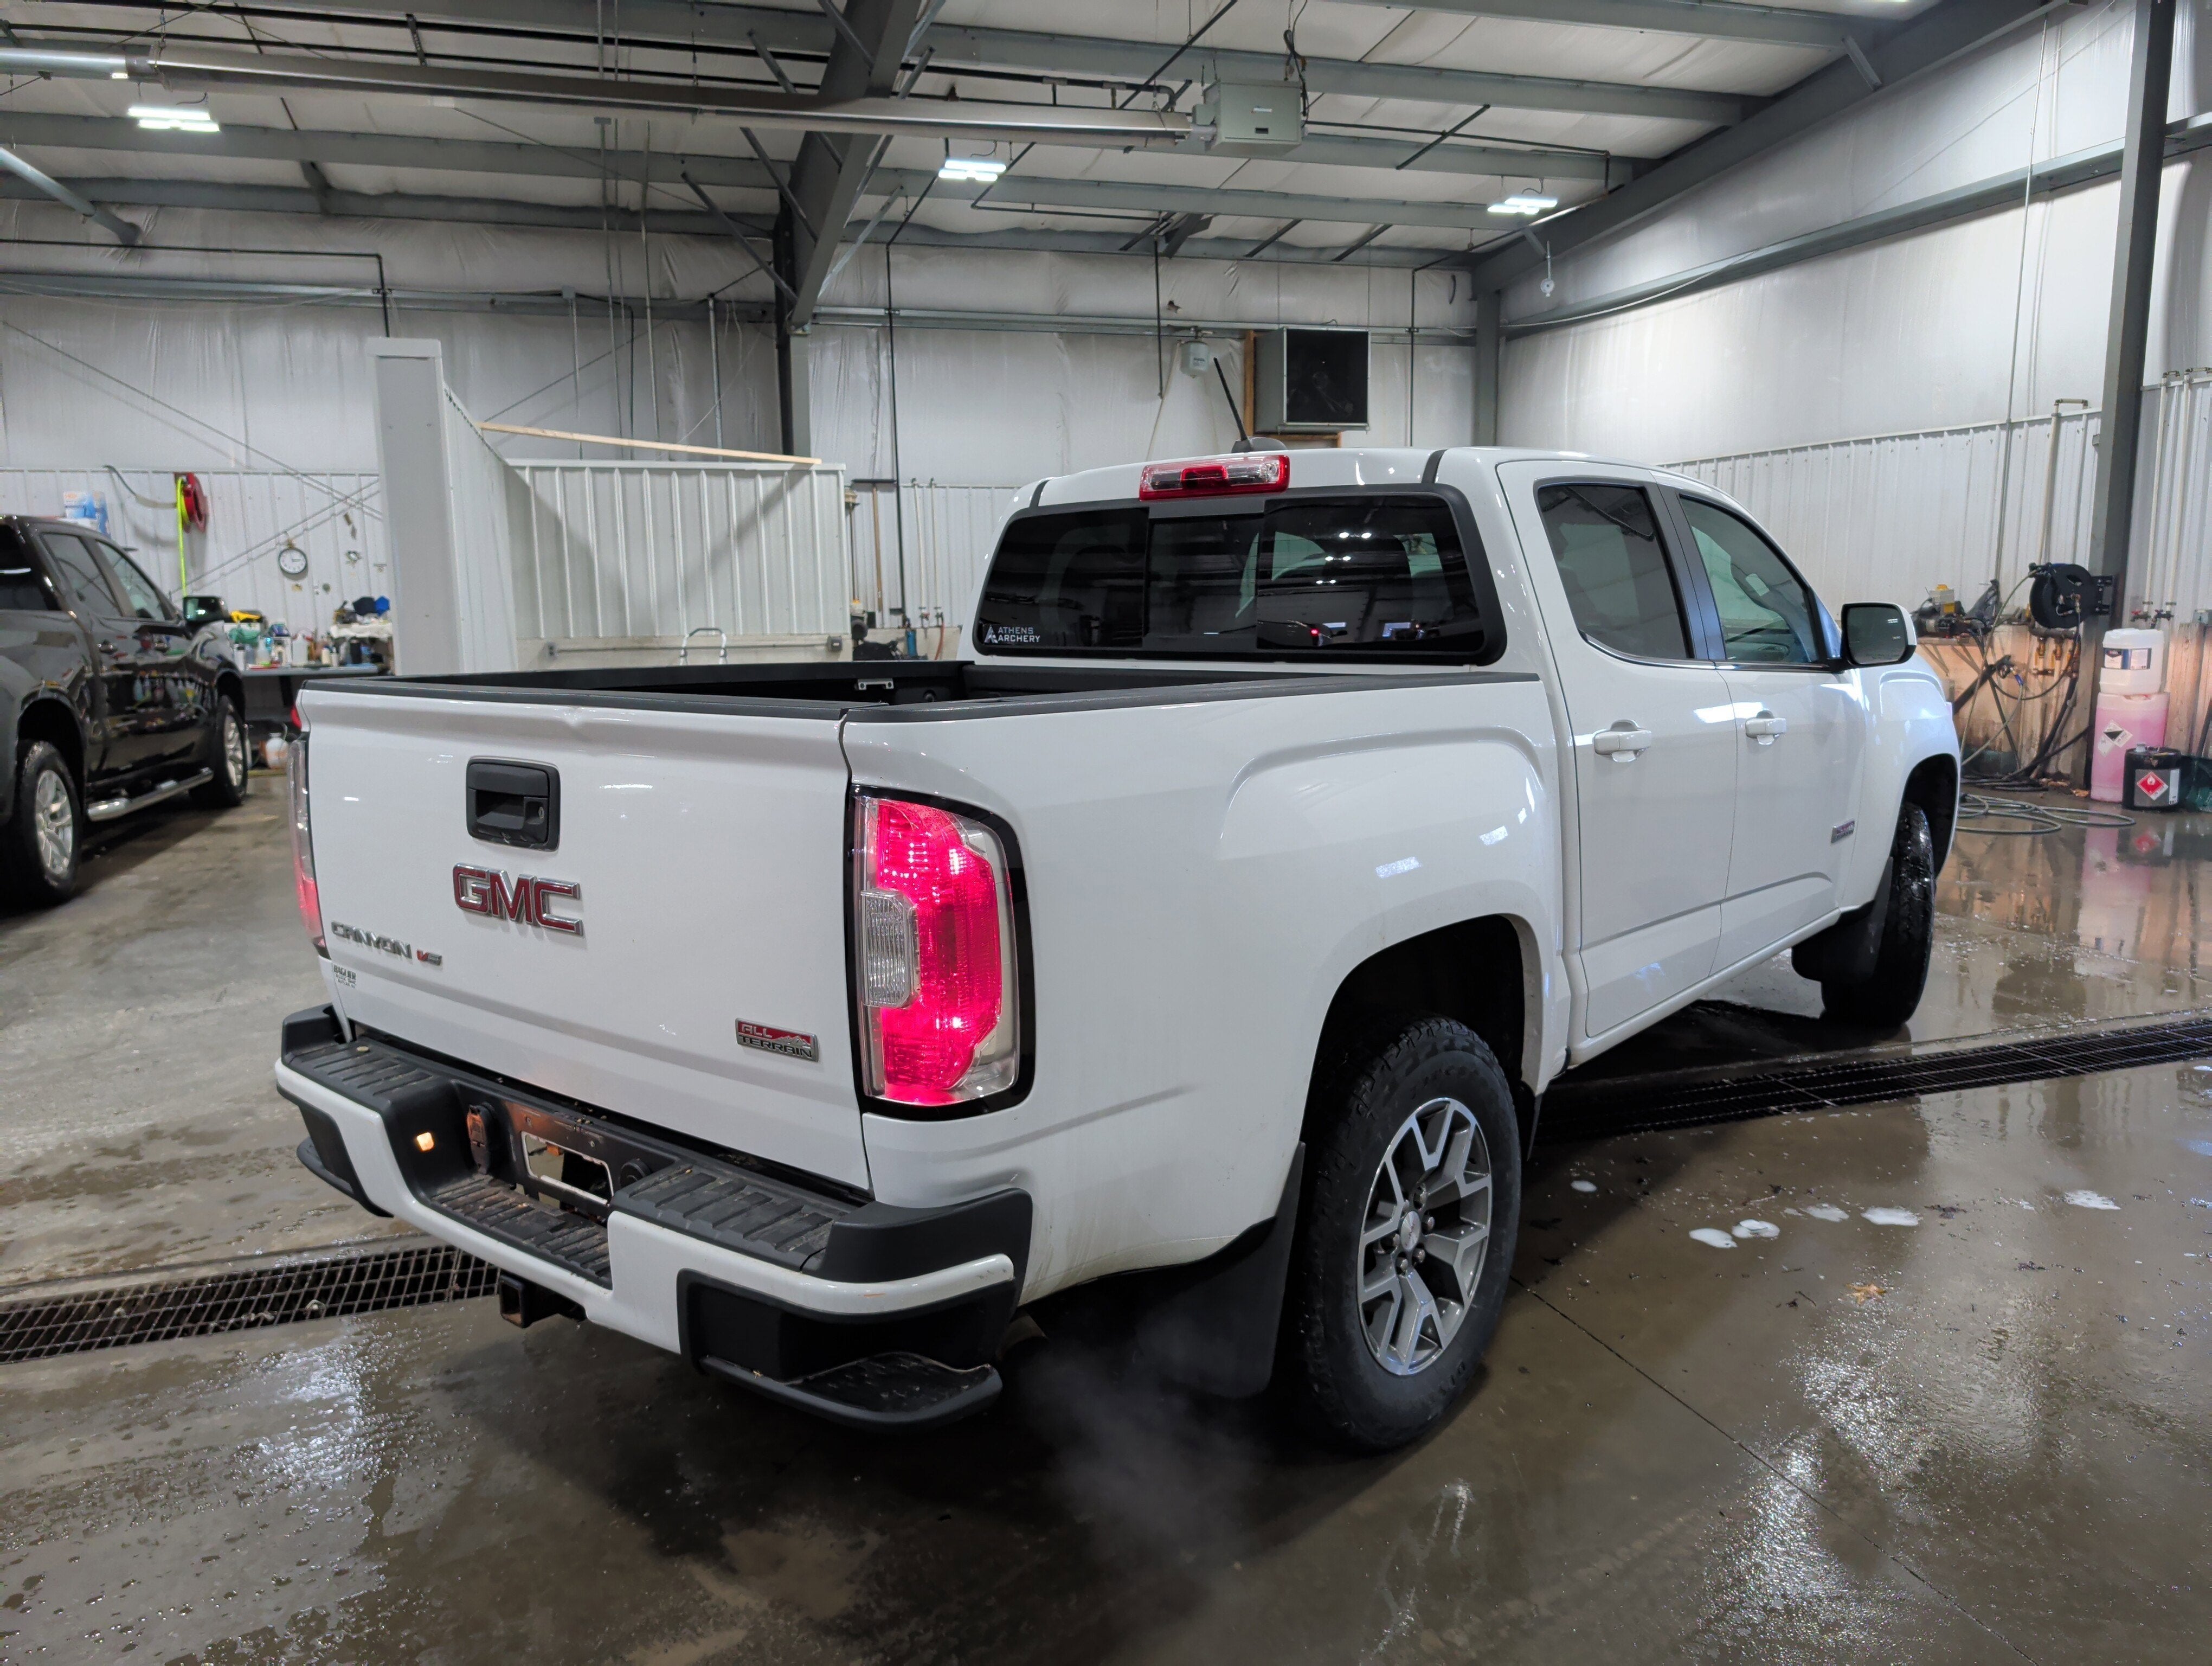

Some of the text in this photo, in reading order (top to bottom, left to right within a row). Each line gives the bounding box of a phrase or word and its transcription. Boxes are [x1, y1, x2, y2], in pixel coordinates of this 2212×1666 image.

[453, 863, 584, 937] GMC
[331, 921, 413, 959] CANYON
[742, 1024, 772, 1038] ALL
[739, 1035, 812, 1059] TERRAIN
